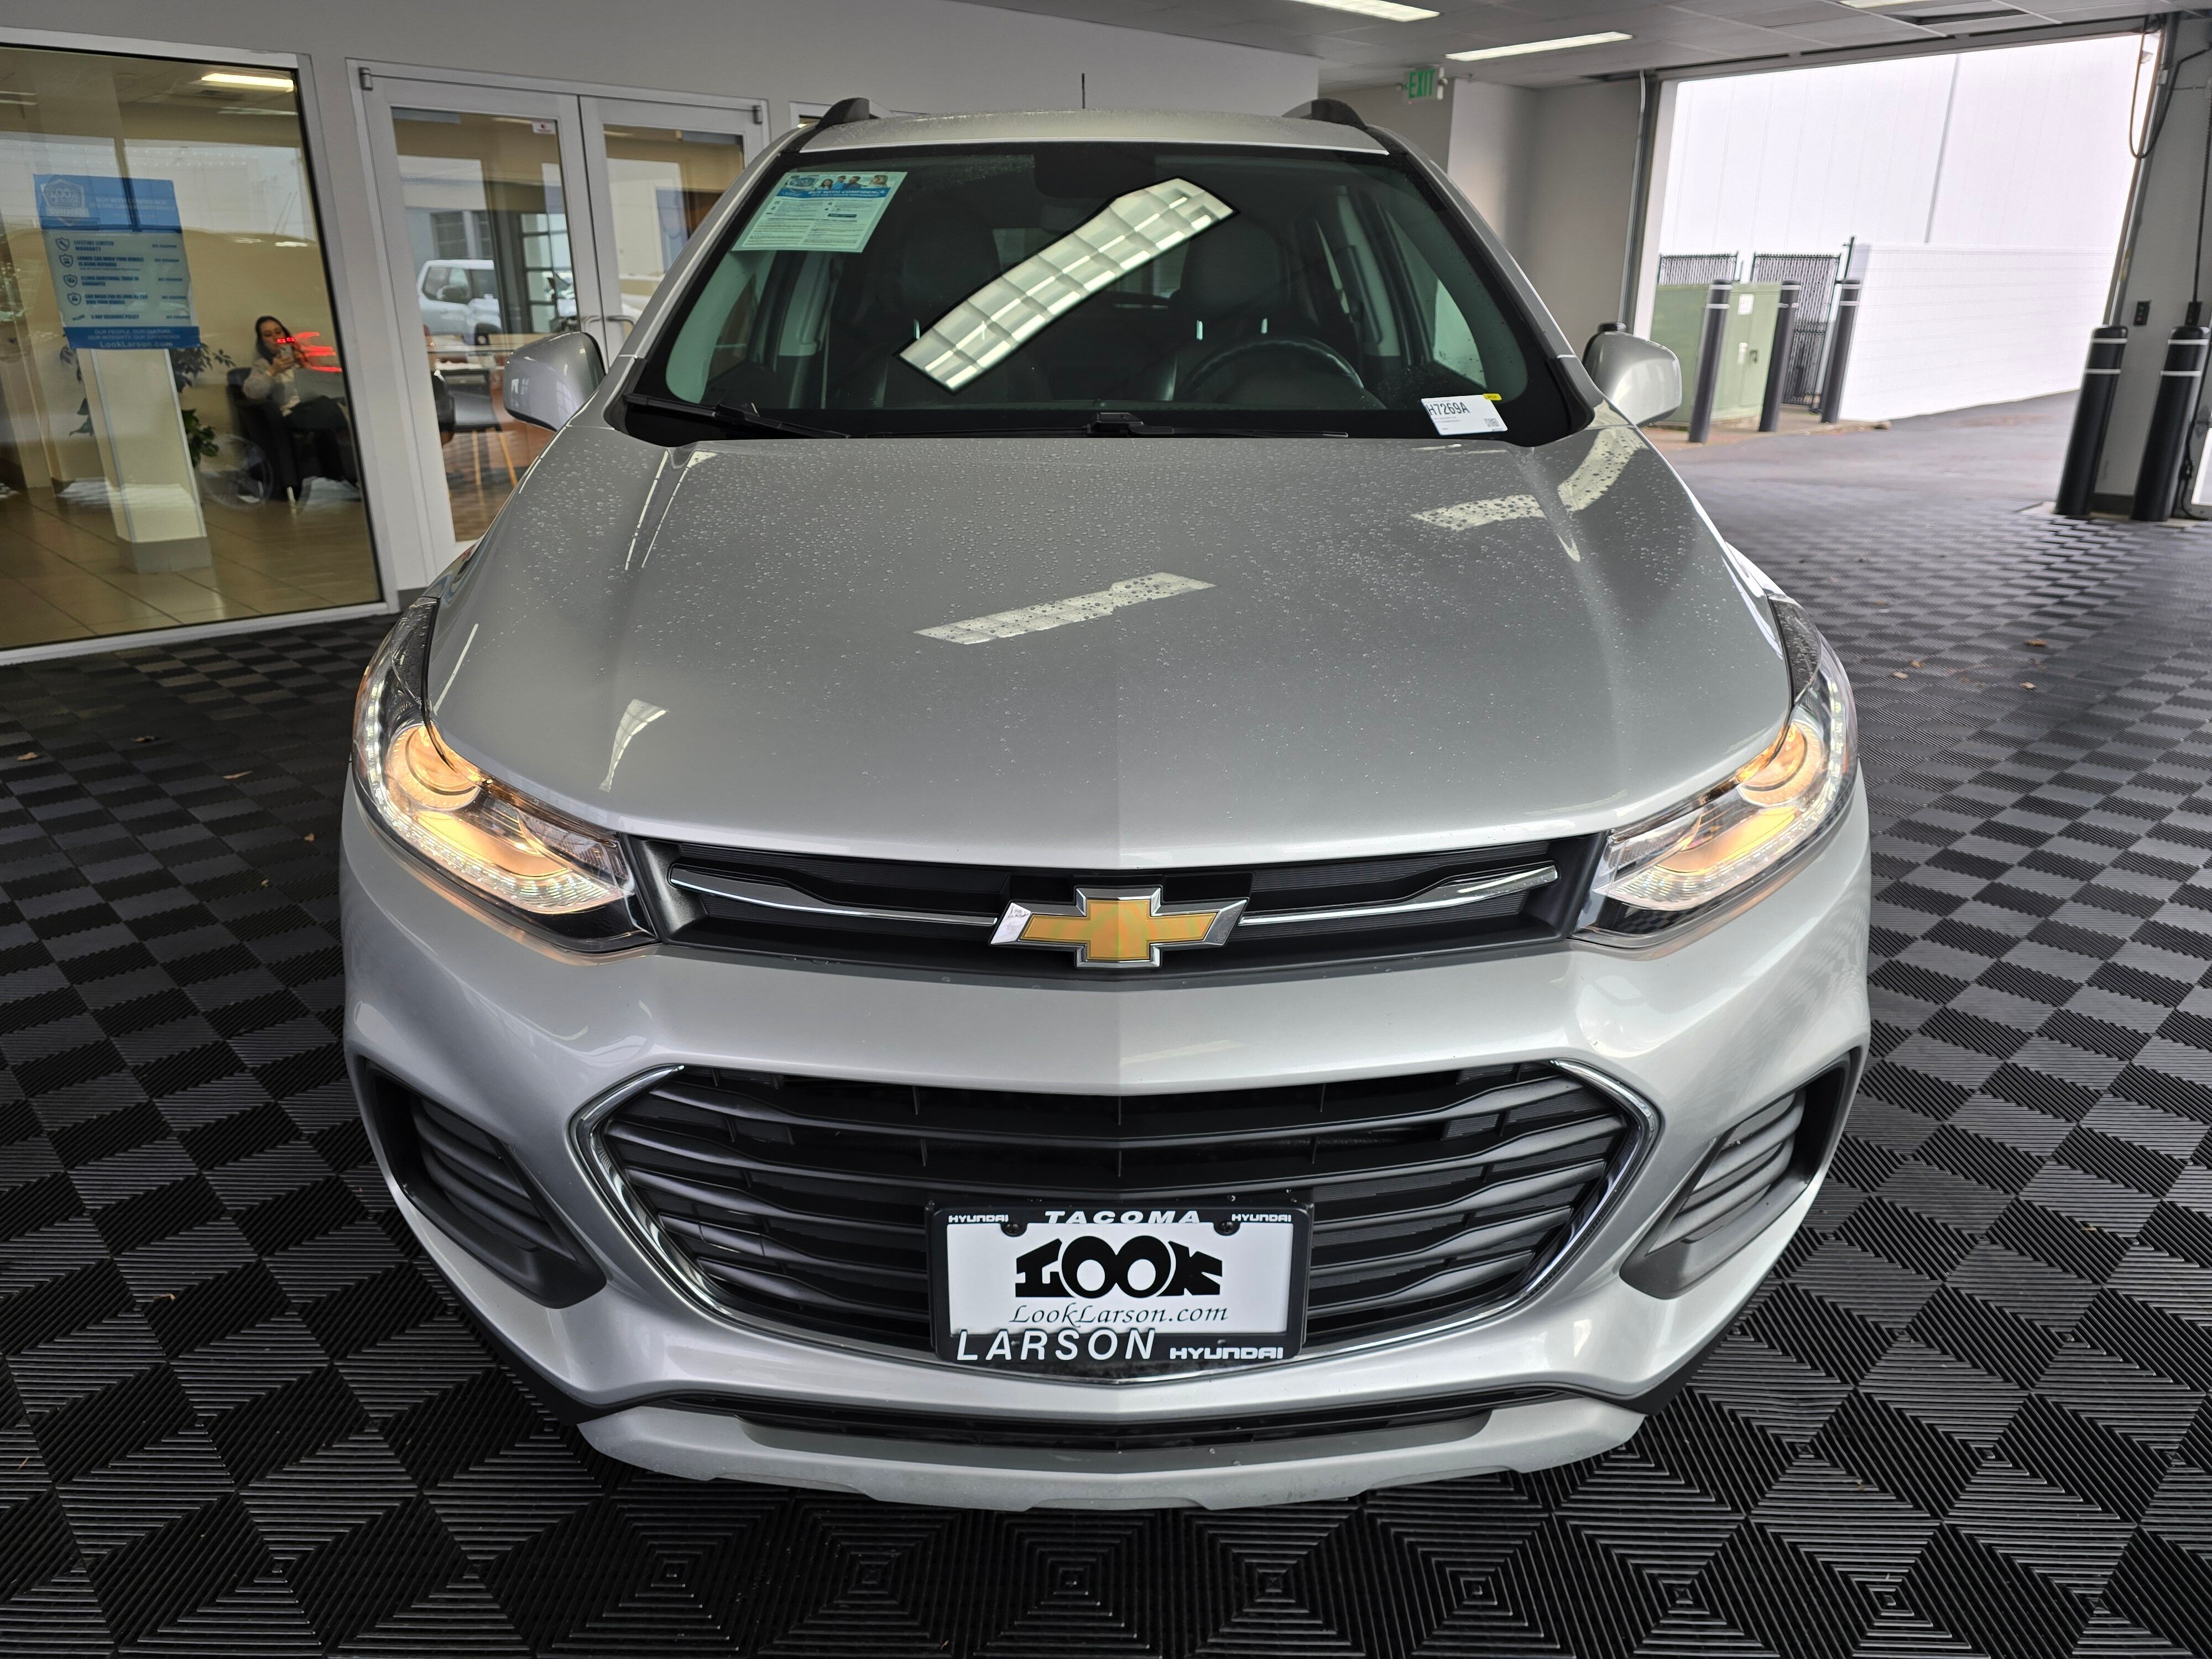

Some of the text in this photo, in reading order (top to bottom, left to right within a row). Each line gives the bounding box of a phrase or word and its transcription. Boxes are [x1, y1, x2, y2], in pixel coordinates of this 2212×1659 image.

[1426, 402, 1471, 415] H7269A
[948, 1215, 1009, 1223] HYUNDAI
[1045, 1211, 1200, 1224] TACOMA
[1232, 1214, 1292, 1222] HYUNDAI
[1015, 1235, 1223, 1298] LOOK
[1008, 1302, 1229, 1328] LookLarson.com
[957, 1328, 1155, 1360] LARSON
[1170, 1347, 1284, 1359] HYUNDAI
